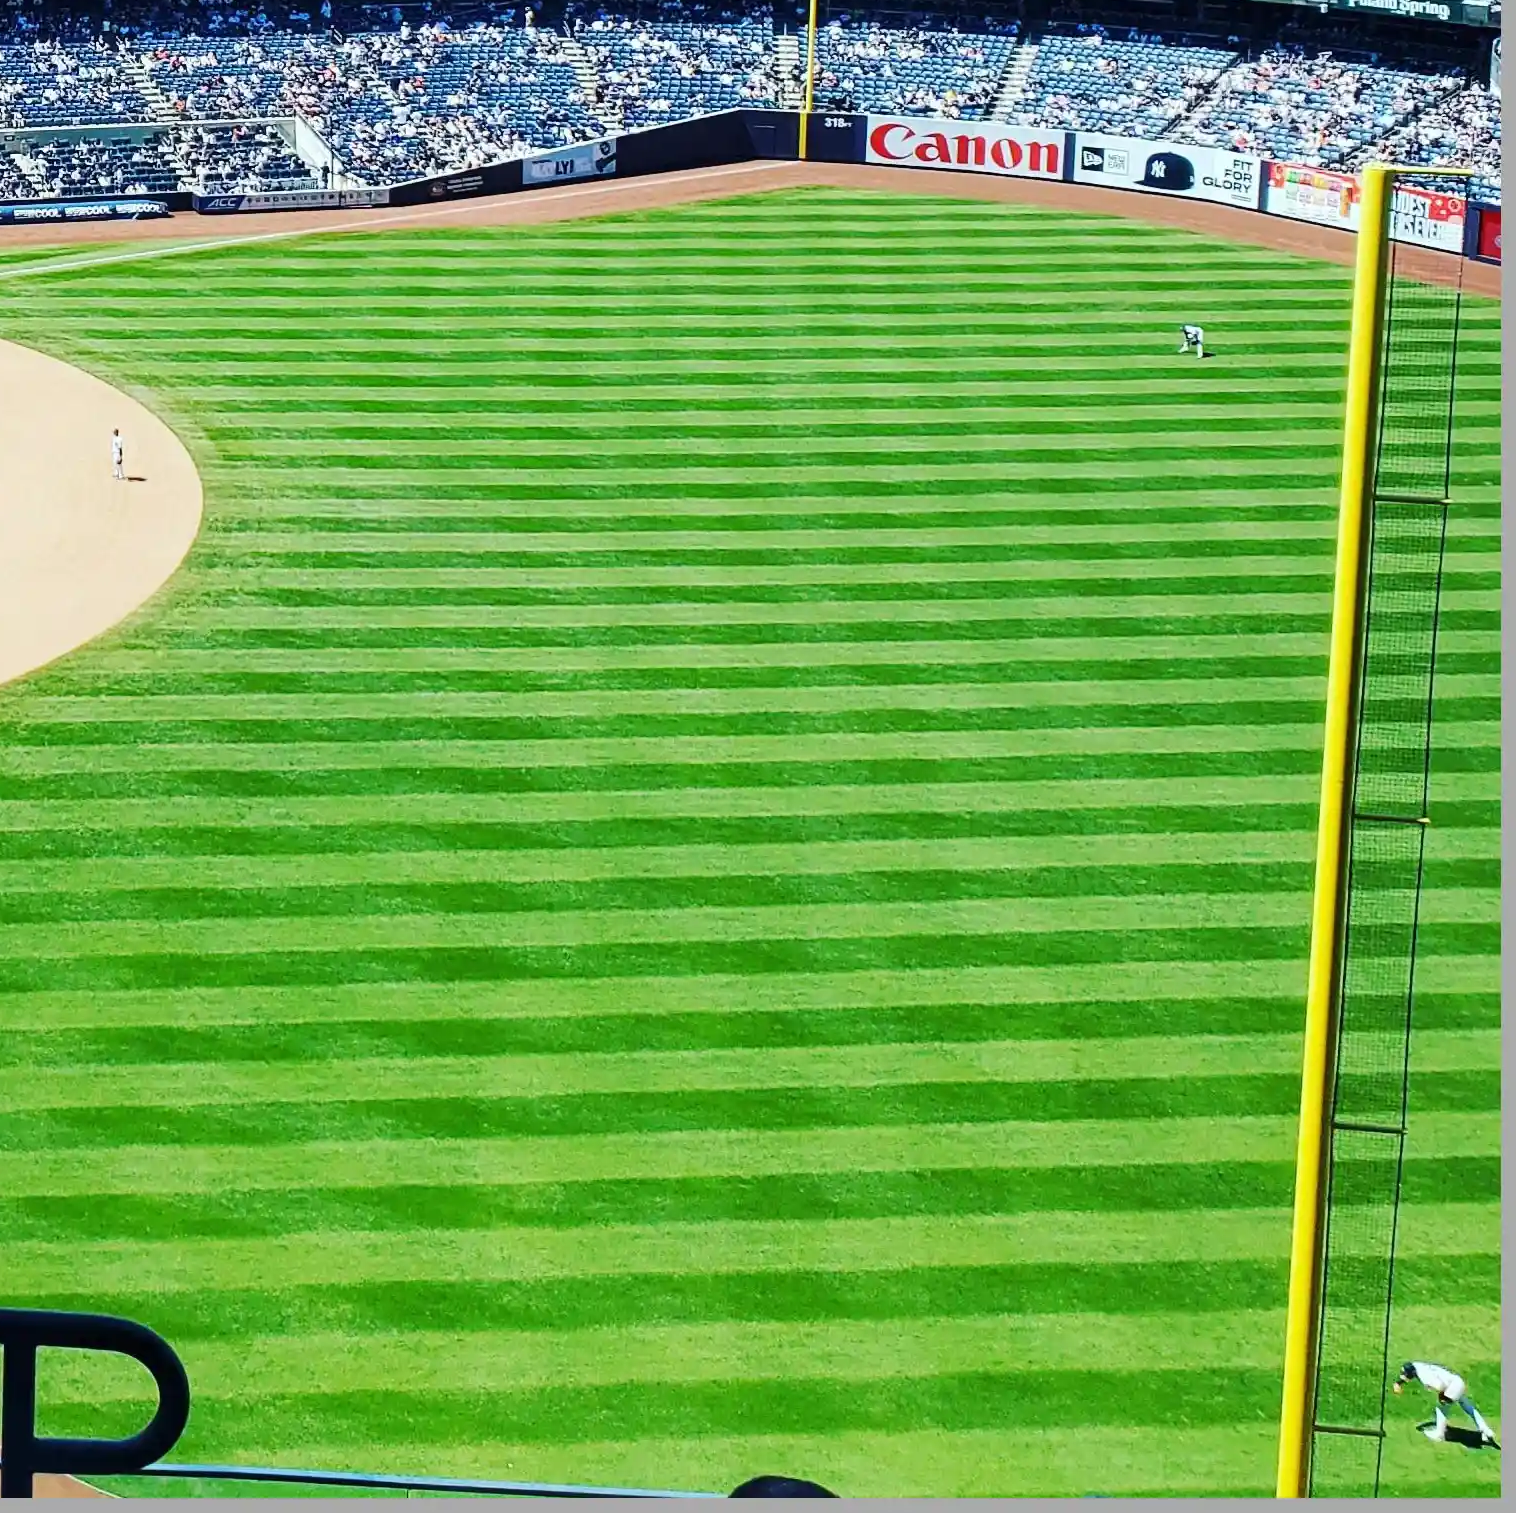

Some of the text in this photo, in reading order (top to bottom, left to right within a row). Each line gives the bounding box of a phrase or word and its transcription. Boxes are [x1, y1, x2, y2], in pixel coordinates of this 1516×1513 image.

[870, 123, 1060, 174] Canon
[1232, 158, 1254, 173] FIT
[1224, 168, 1253, 183] FOR
[1202, 177, 1252, 194] GLORY
[137, 203, 163, 213] COOL
[208, 197, 238, 208] ACC
[35, 209, 62, 219] COOL
[86, 206, 113, 215] COOL
